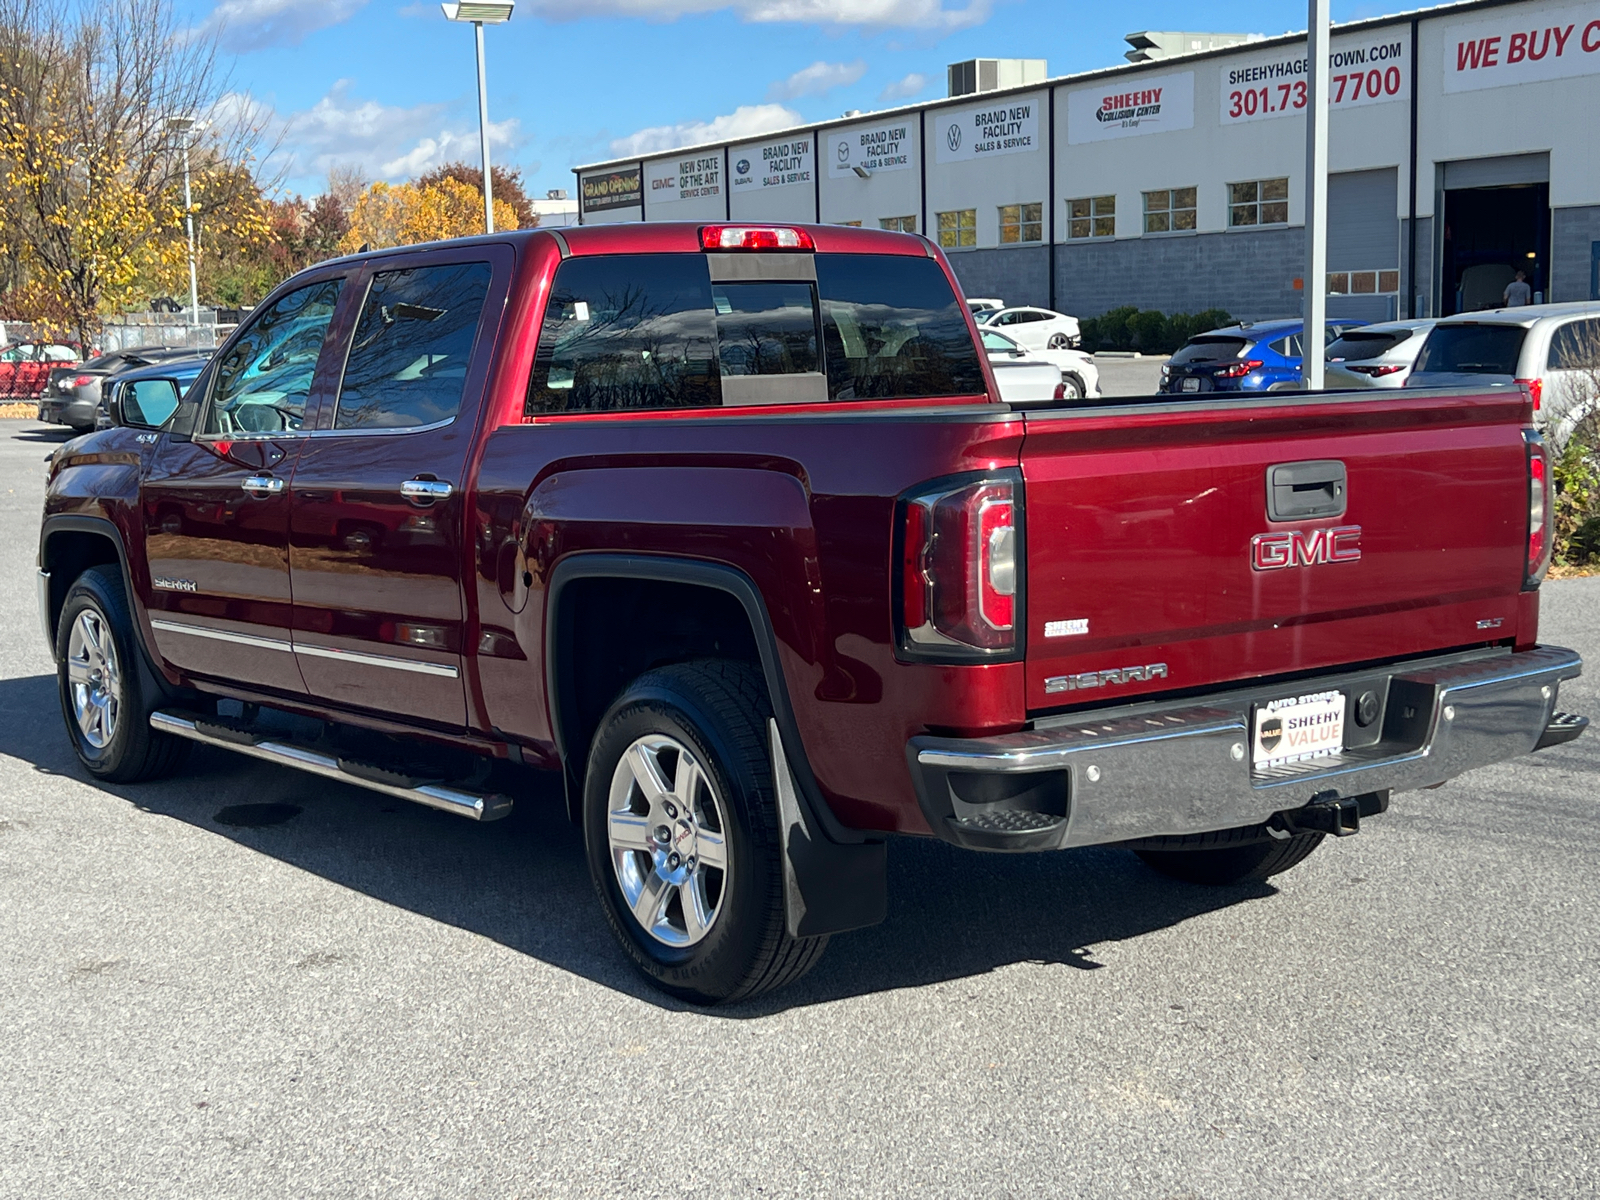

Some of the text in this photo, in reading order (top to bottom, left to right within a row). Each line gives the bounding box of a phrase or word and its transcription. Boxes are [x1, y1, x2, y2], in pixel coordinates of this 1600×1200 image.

[1456, 36, 1502, 72] WE
[1506, 23, 1575, 64] BUY
[1102, 87, 1163, 111] SHEEHY
[975, 106, 1031, 127] BRAND NEW
[1136, 104, 1161, 117] CENTER
[860, 127, 906, 146] BRAND NEW
[983, 121, 1022, 139] FACILITY
[763, 141, 809, 160] BRAND NEW
[866, 142, 899, 157] FACILITY
[975, 136, 1031, 152] SALES & SERVICE
[679, 157, 719, 174] NEW STATE
[769, 156, 802, 173] FACILITY
[884, 155, 907, 166] SERVICE
[584, 176, 640, 197] GRAND OPENING
[652, 177, 675, 190] GMC
[680, 171, 719, 188] OF THE ART
[763, 176, 780, 186] SALES
[786, 171, 810, 183] SERVICE
[680, 186, 719, 199] SERVICE CENTER
[1251, 524, 1362, 571] GMC
[1044, 662, 1168, 694] SIERRA
[1266, 698, 1297, 710] AUTO
[1288, 710, 1340, 729] SHEEHY
[1288, 723, 1340, 747] VALUE
